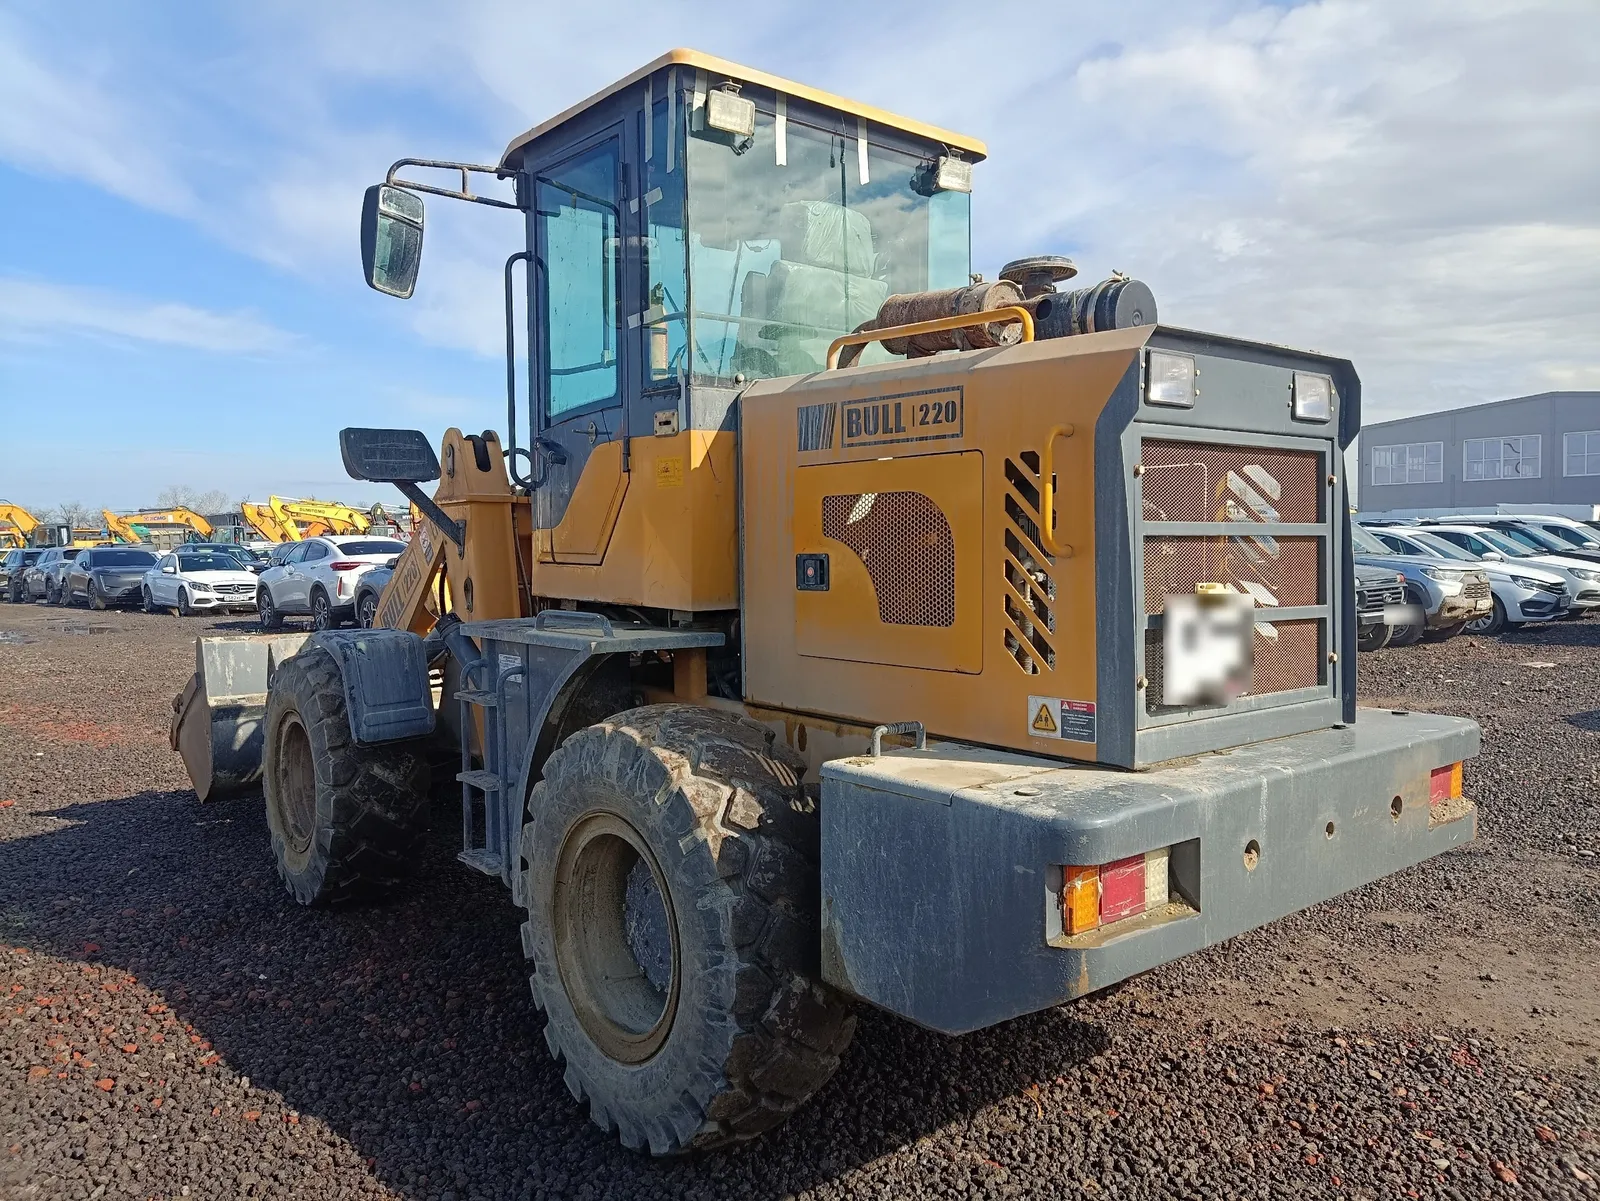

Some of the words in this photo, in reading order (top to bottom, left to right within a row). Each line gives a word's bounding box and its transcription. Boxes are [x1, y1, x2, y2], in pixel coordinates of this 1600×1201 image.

[847, 402, 906, 438] BULL
[919, 400, 957, 427] 220
[299, 507, 326, 515] SUMITOMO
[382, 586, 405, 628] BULL
[403, 561, 418, 593] 220
